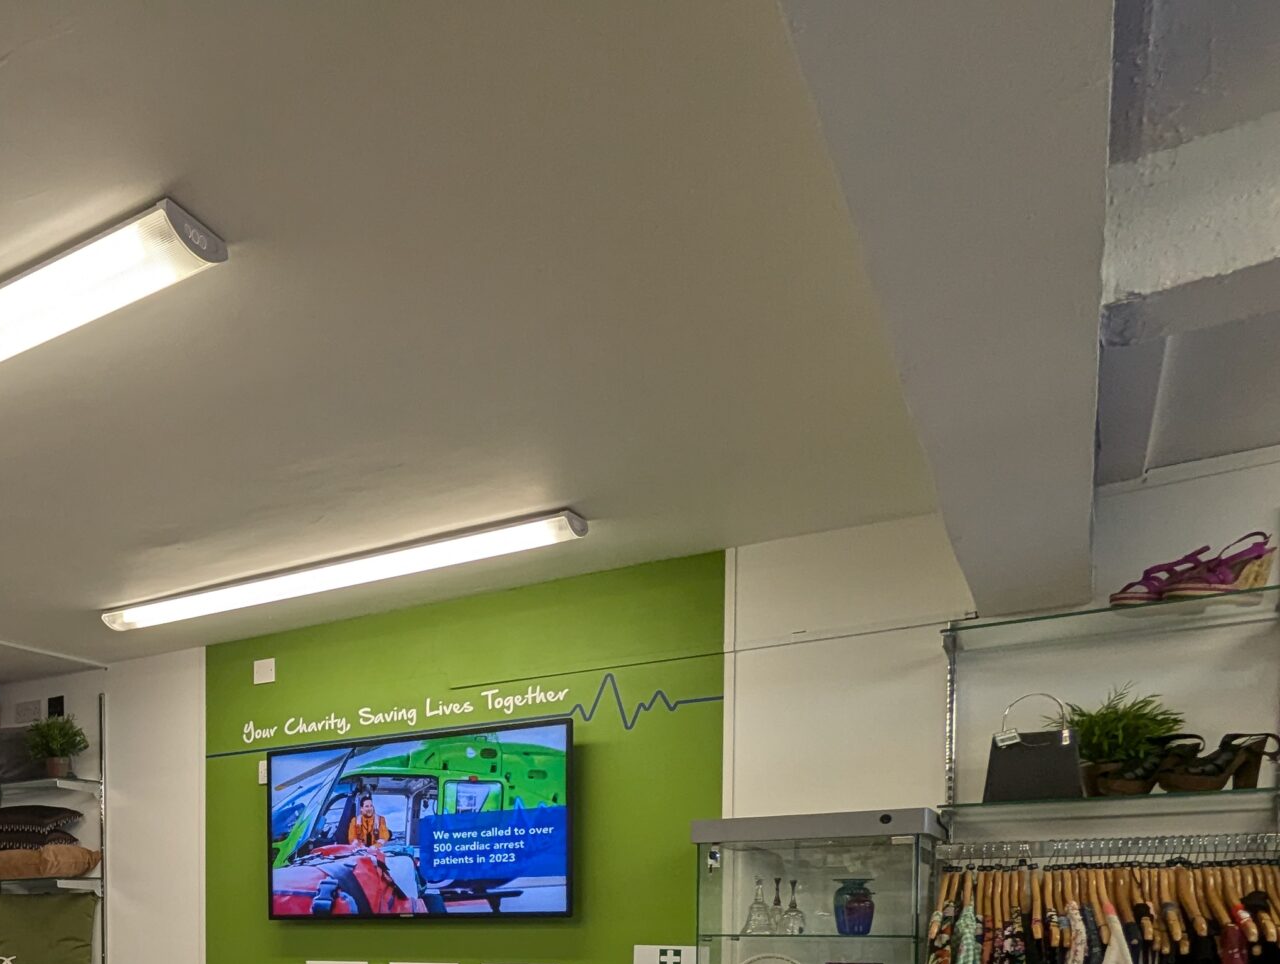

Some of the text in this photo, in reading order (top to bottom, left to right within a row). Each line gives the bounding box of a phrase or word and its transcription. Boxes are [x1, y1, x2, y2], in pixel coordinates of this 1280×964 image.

[242, 687, 570, 743] Your Charity, Saving Lives Together
[433, 826, 554, 840] We were called to over
[433, 840, 525, 853] 500 cardiac arrest
[433, 853, 516, 867] patients in 2023
